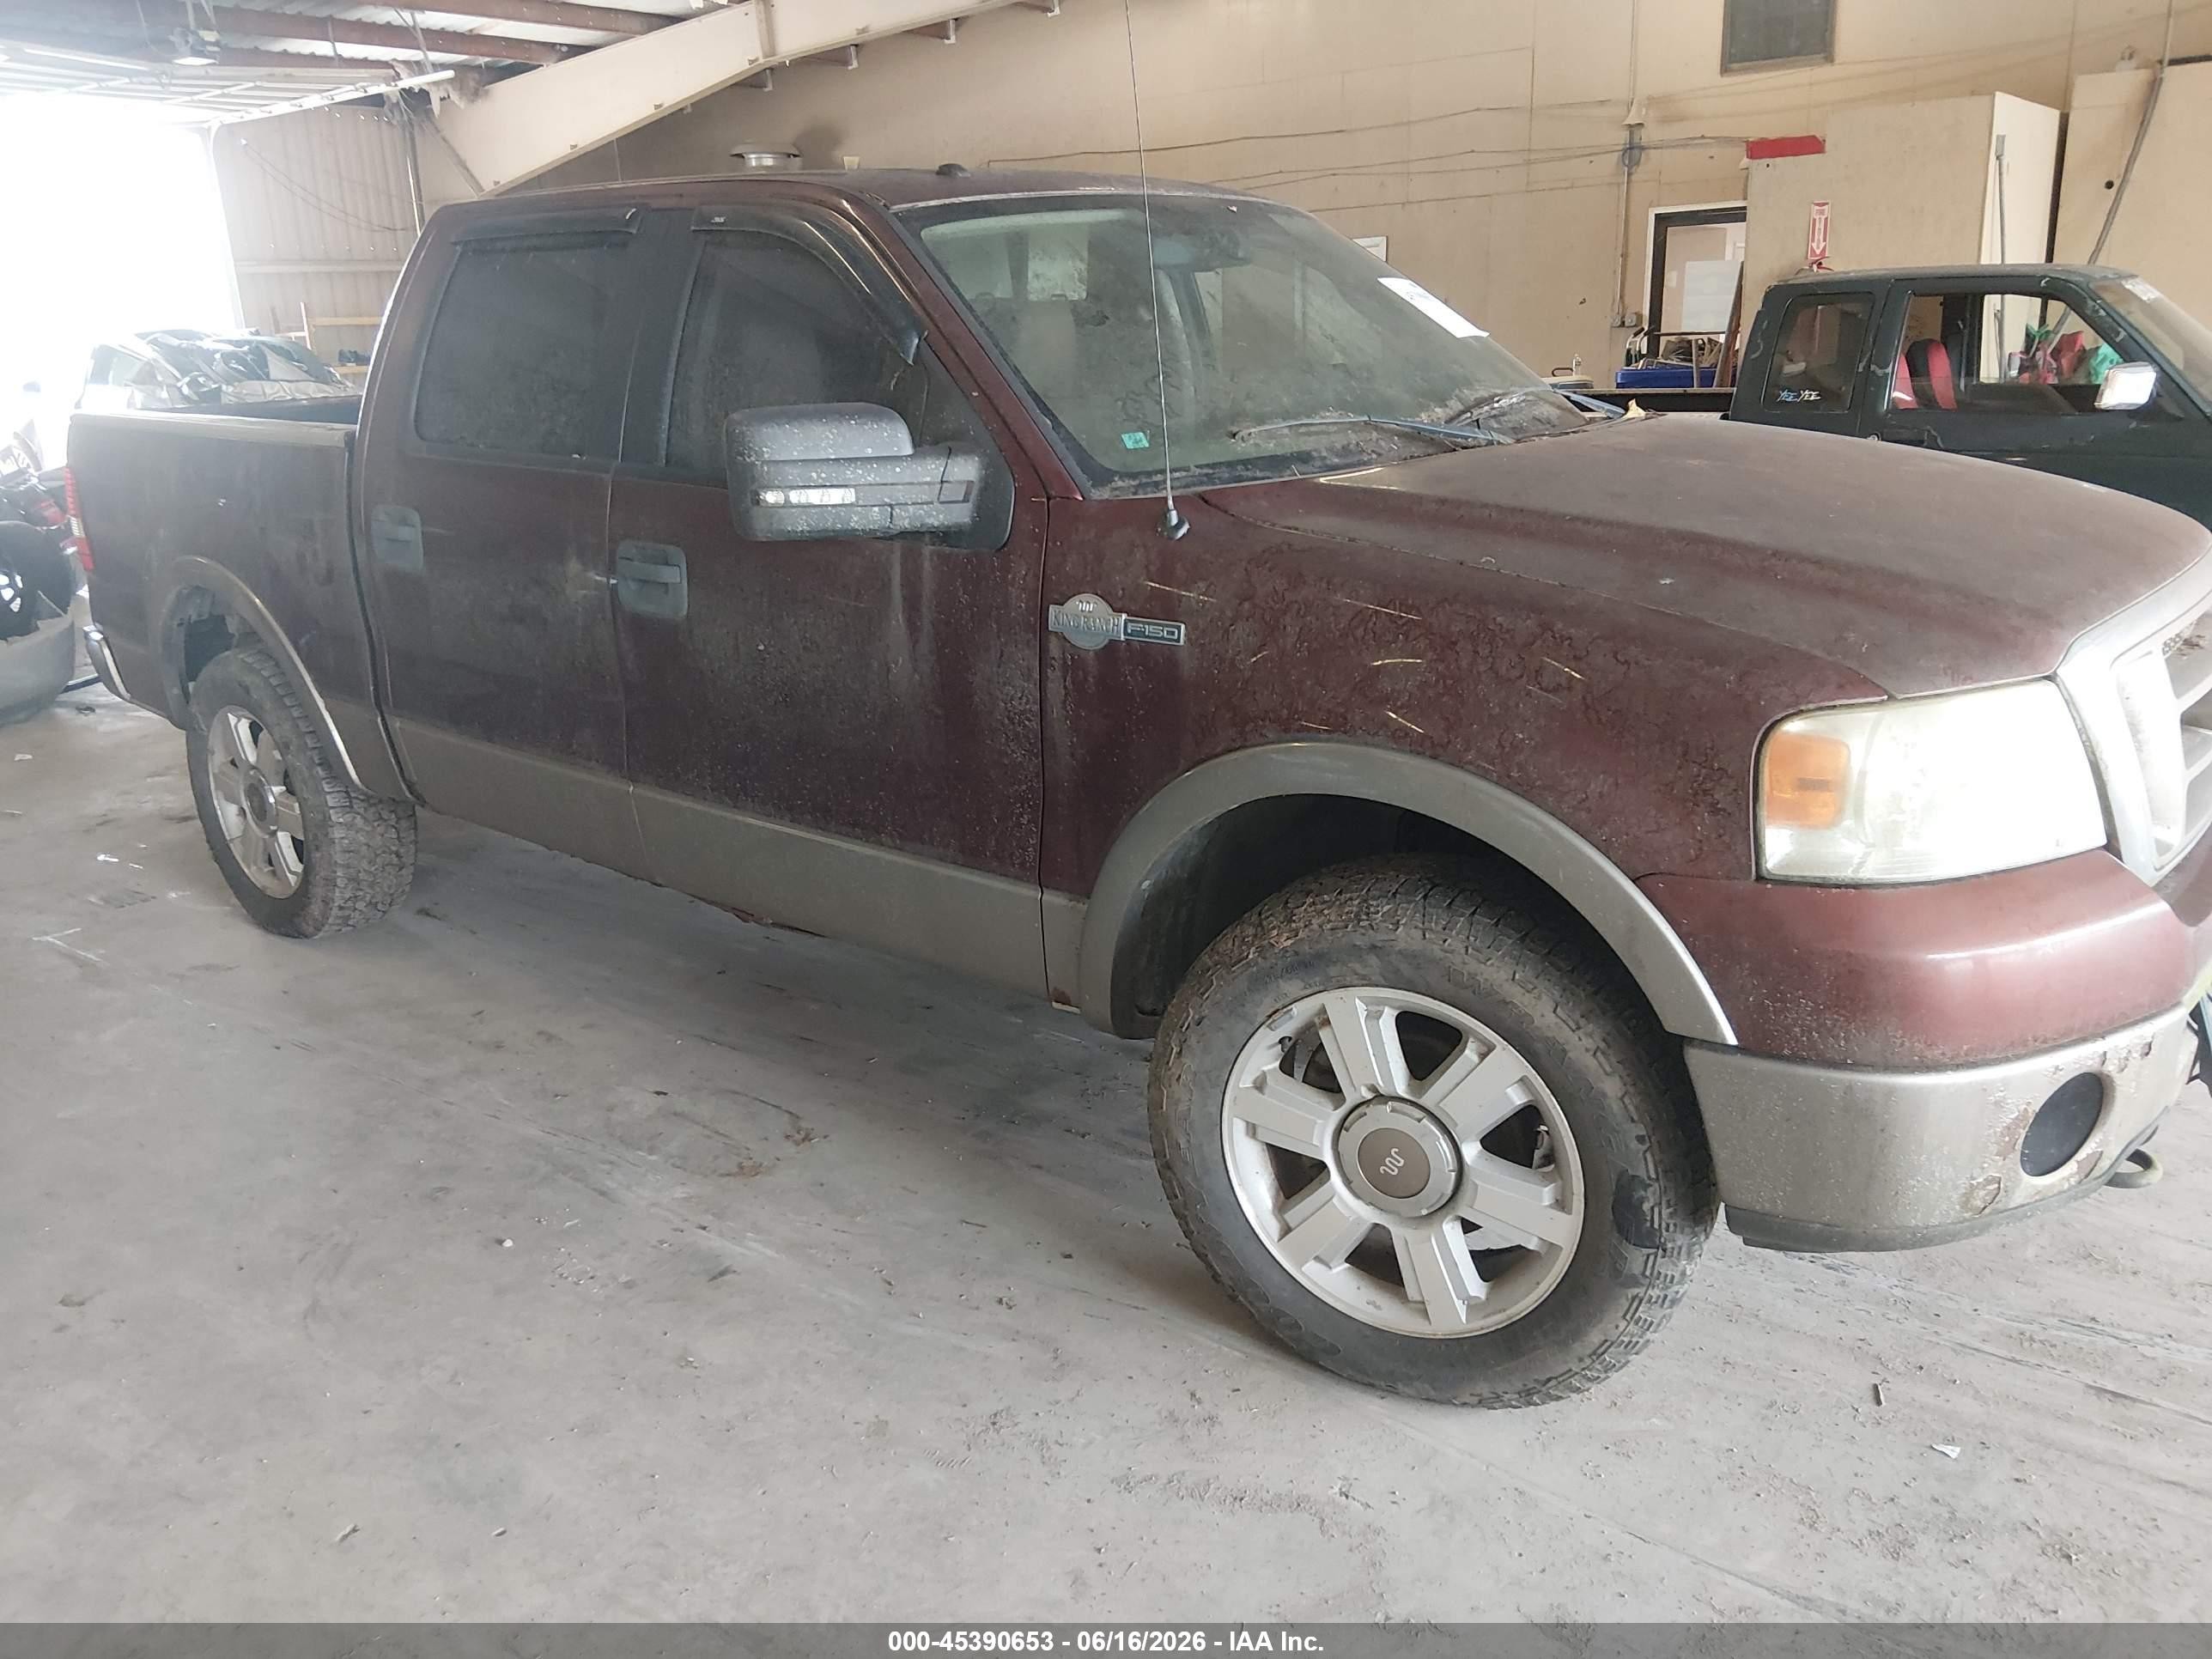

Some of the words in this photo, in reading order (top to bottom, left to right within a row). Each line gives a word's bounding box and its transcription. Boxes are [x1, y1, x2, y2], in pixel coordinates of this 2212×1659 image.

[1776, 389, 1797, 402] YEE
[1797, 389, 1821, 402] YEE
[1052, 609, 1079, 629] KING
[1080, 615, 1121, 636] RANCH
[1127, 623, 1179, 640] F-150
